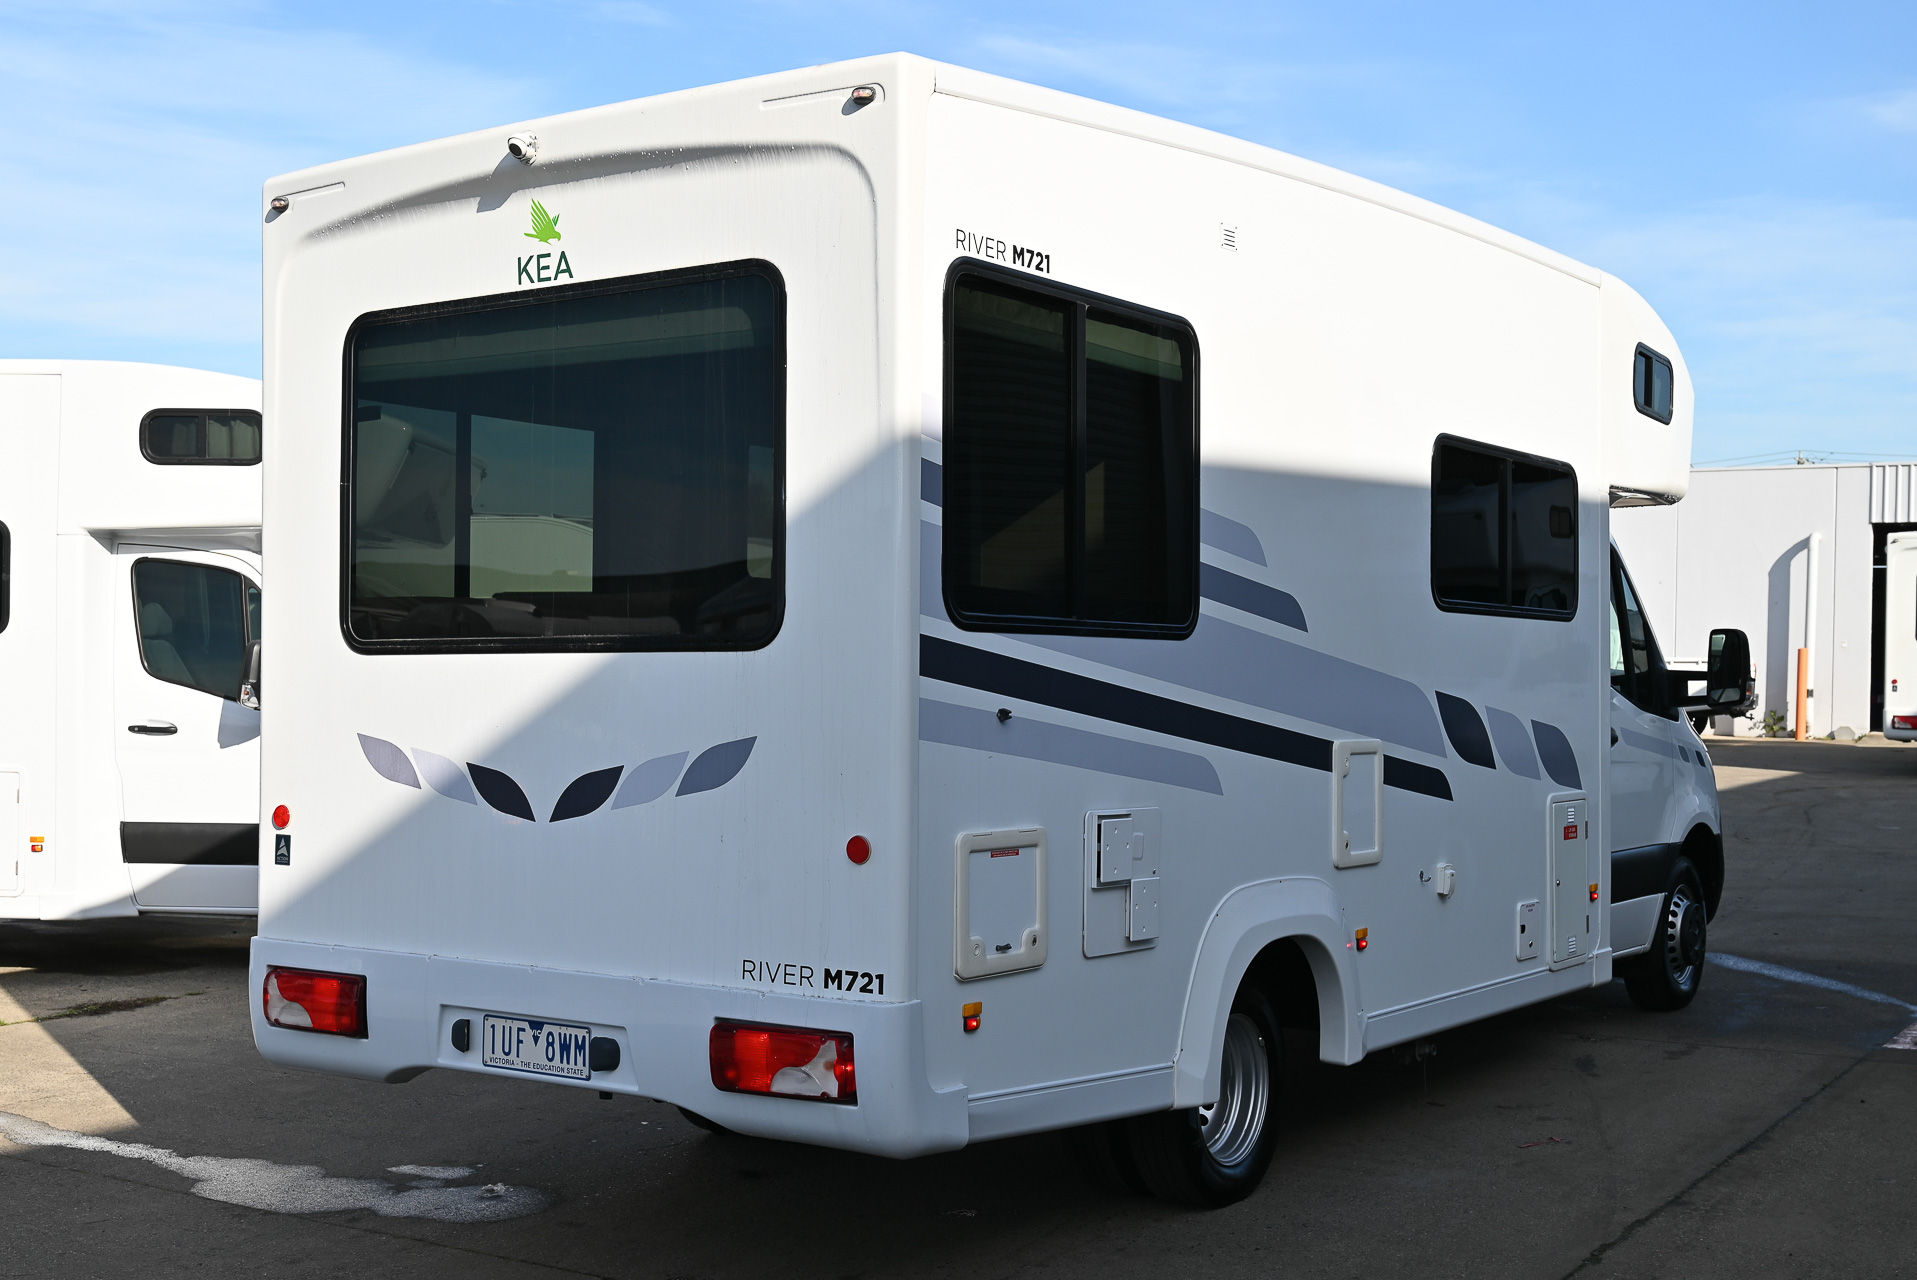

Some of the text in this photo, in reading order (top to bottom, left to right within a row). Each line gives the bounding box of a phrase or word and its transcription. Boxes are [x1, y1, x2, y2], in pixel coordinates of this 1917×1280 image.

[517, 250, 574, 286] KEA
[955, 228, 1050, 274] RIVER M721
[742, 959, 885, 996] RIVER M721
[490, 1023, 587, 1068] 1UF 8WM
[489, 1056, 515, 1067] VICTORIA
[520, 1060, 532, 1069] THE
[532, 1062, 565, 1074] EDUCATION
[566, 1067, 584, 1077] STATE
